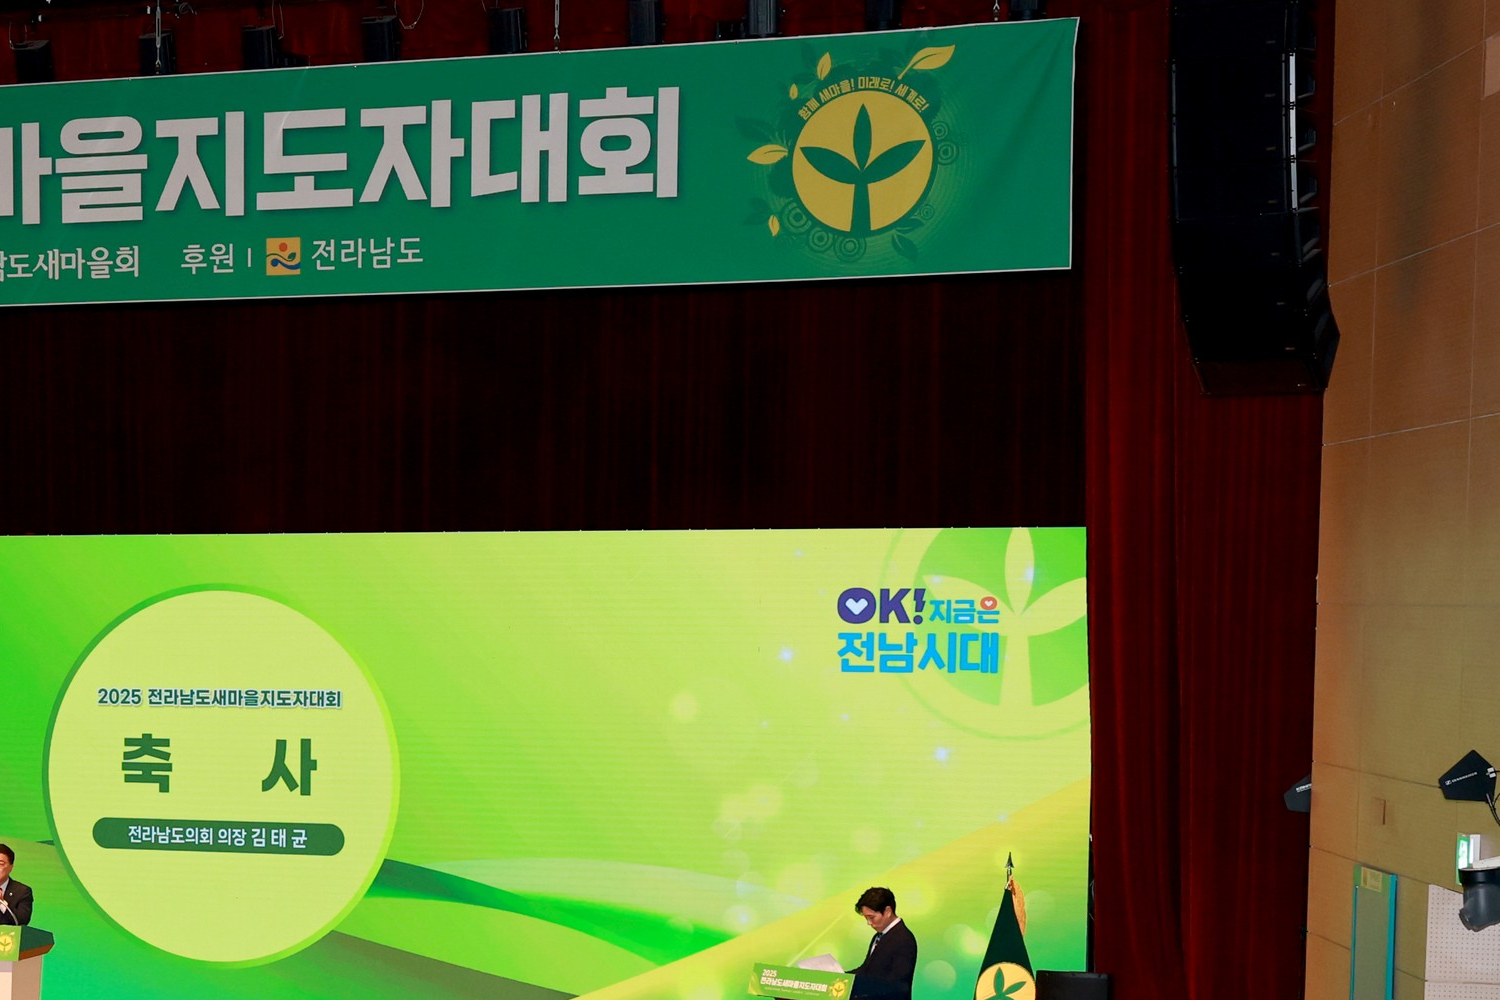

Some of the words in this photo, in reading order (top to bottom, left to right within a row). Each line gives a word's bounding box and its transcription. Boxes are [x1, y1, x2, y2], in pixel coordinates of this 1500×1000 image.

[797, 97, 820, 121] 함께
[819, 77, 856, 103] 새마을!
[857, 75, 895, 92] 미래로!
[894, 82, 931, 113] 세계로!
[180, 243, 234, 275] 후원
[311, 236, 424, 271] 전라남도
[837, 587, 927, 625] OK!
[929, 596, 1001, 624] 지금은
[837, 631, 1000, 674] 전남시대
[97, 688, 142, 706] 2025
[147, 688, 342, 708] 전라남도새마을지도자대회
[128, 824, 214, 846] 전라남도의회
[217, 826, 247, 847] 의장
